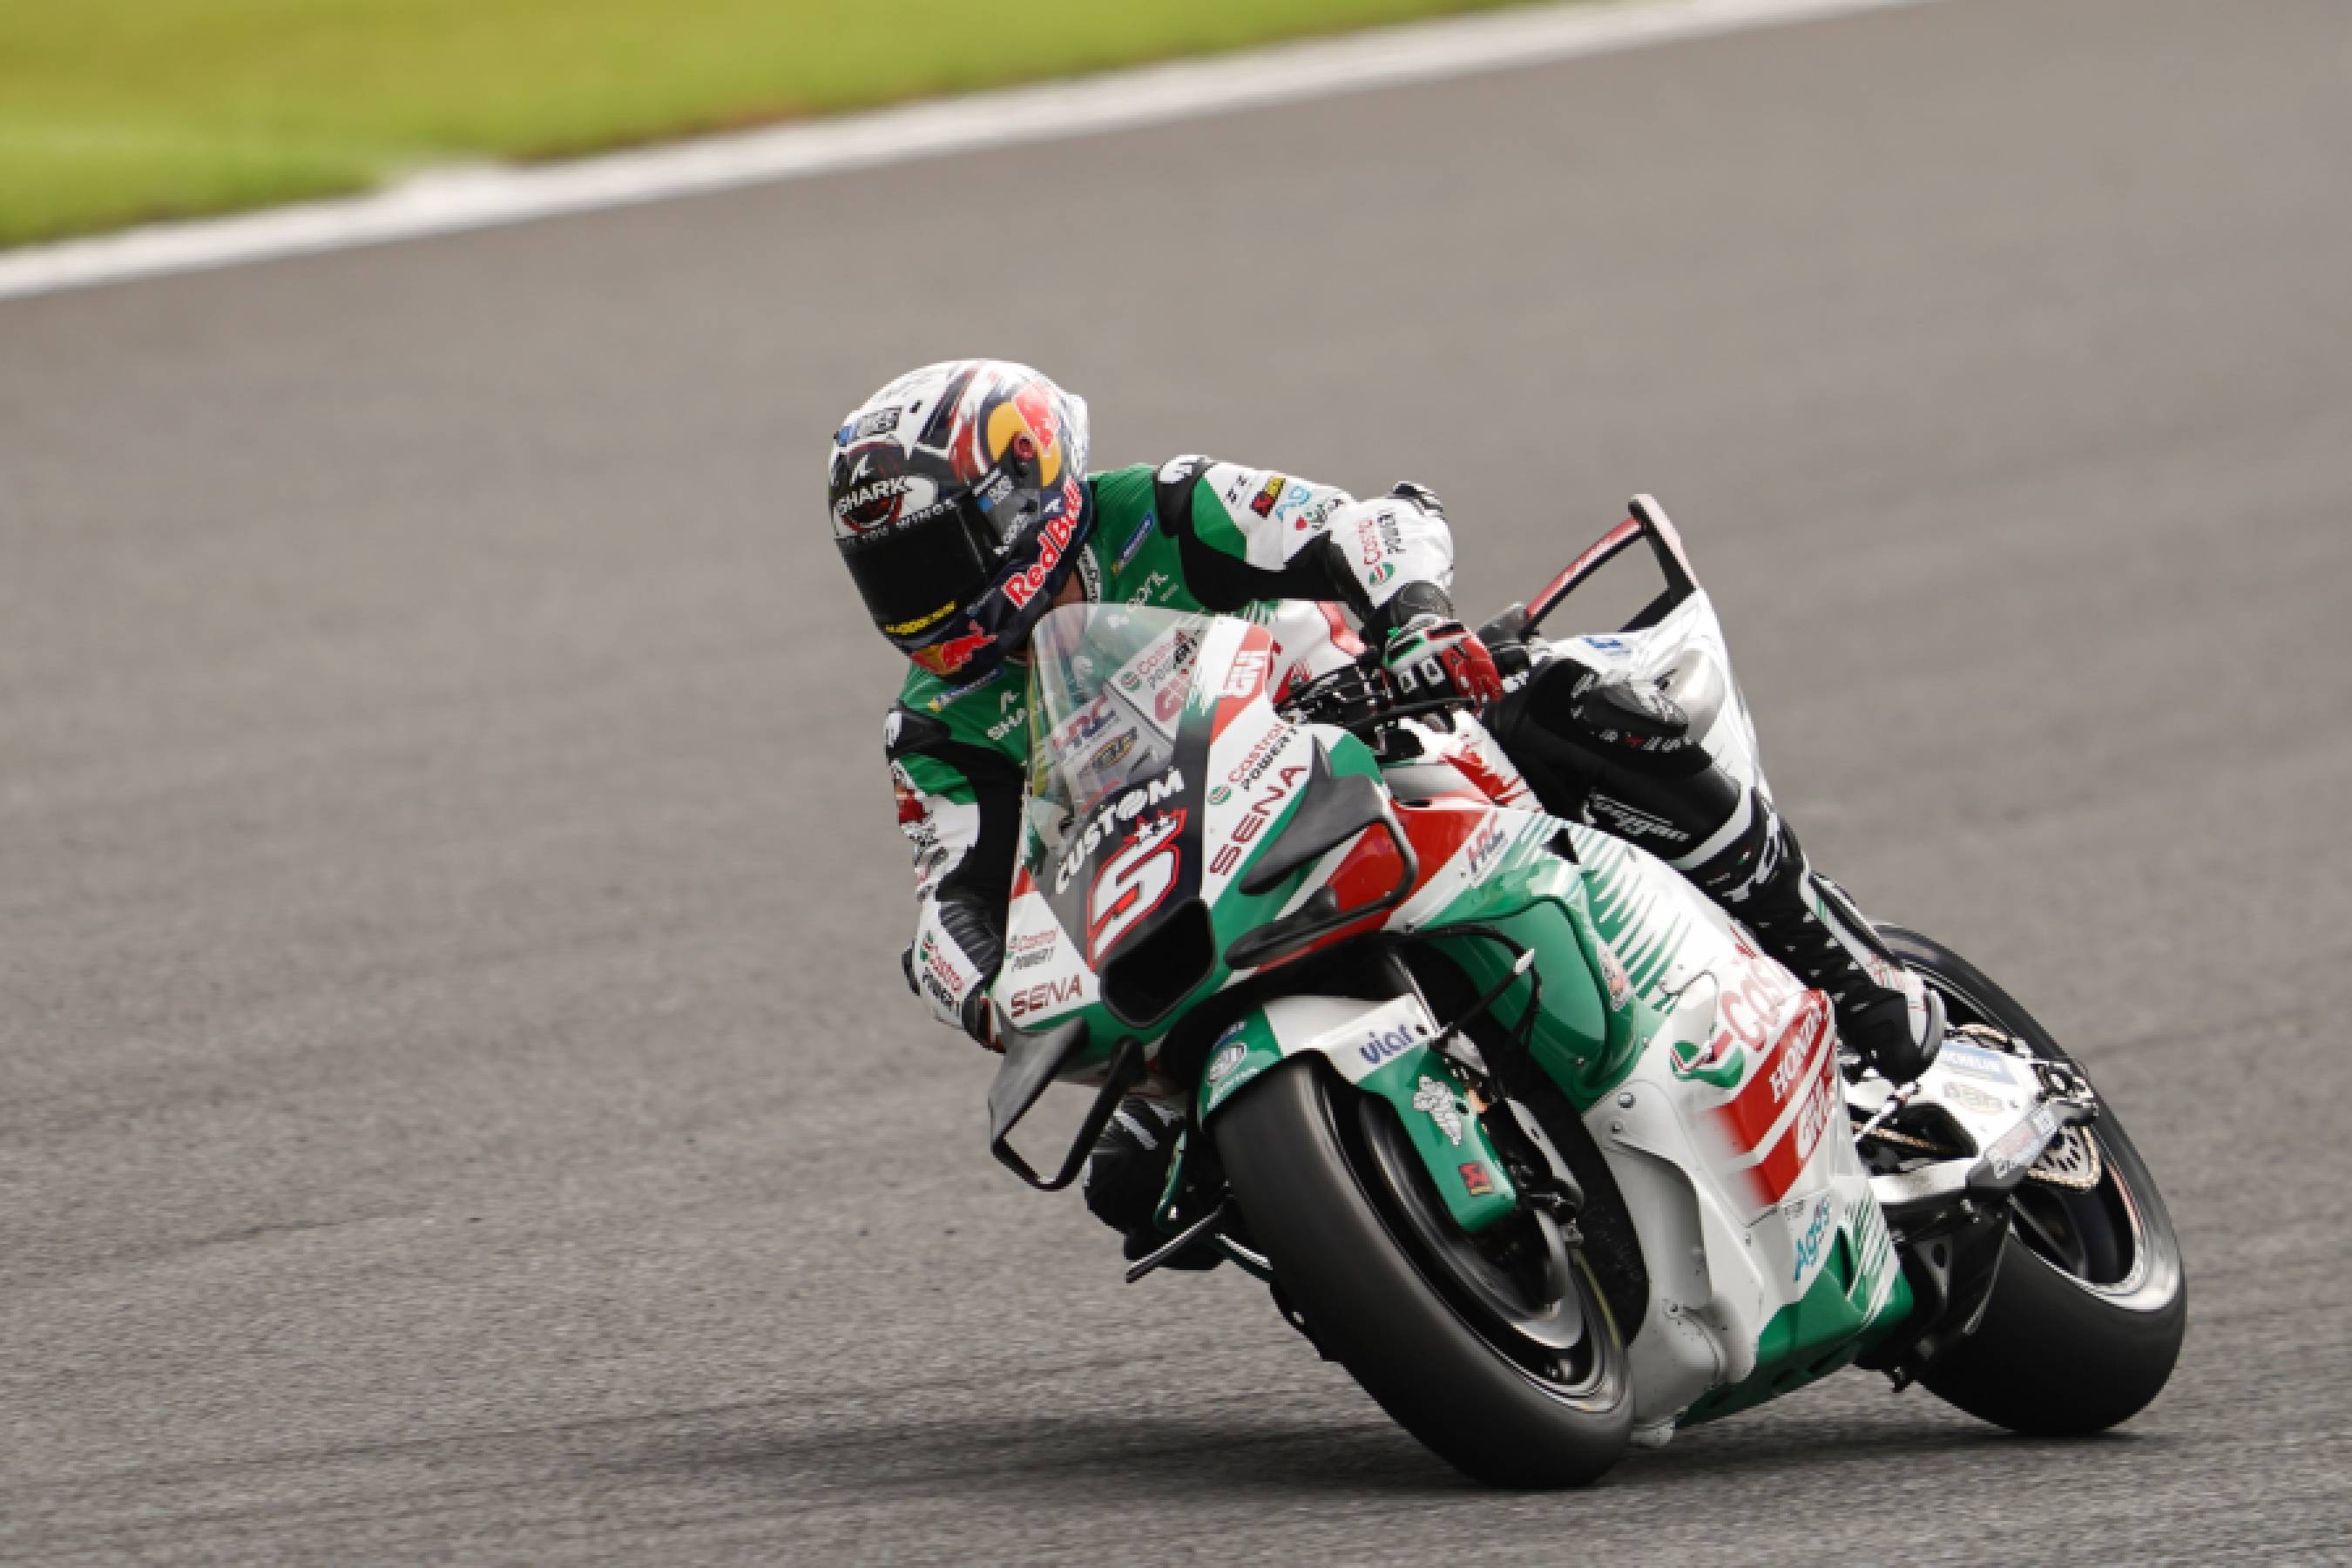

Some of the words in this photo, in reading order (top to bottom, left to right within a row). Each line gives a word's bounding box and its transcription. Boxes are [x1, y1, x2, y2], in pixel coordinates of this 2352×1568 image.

[835, 476, 911, 512] SHARK
[1002, 530, 1061, 610] Red
[1047, 476, 1082, 551] Bull
[986, 708, 1026, 740] SHA
[1227, 723, 1284, 782] Castrol
[1055, 767, 1186, 895] CUSTOM
[1209, 765, 1308, 876] SENA
[1010, 974, 1083, 1018] SENA
